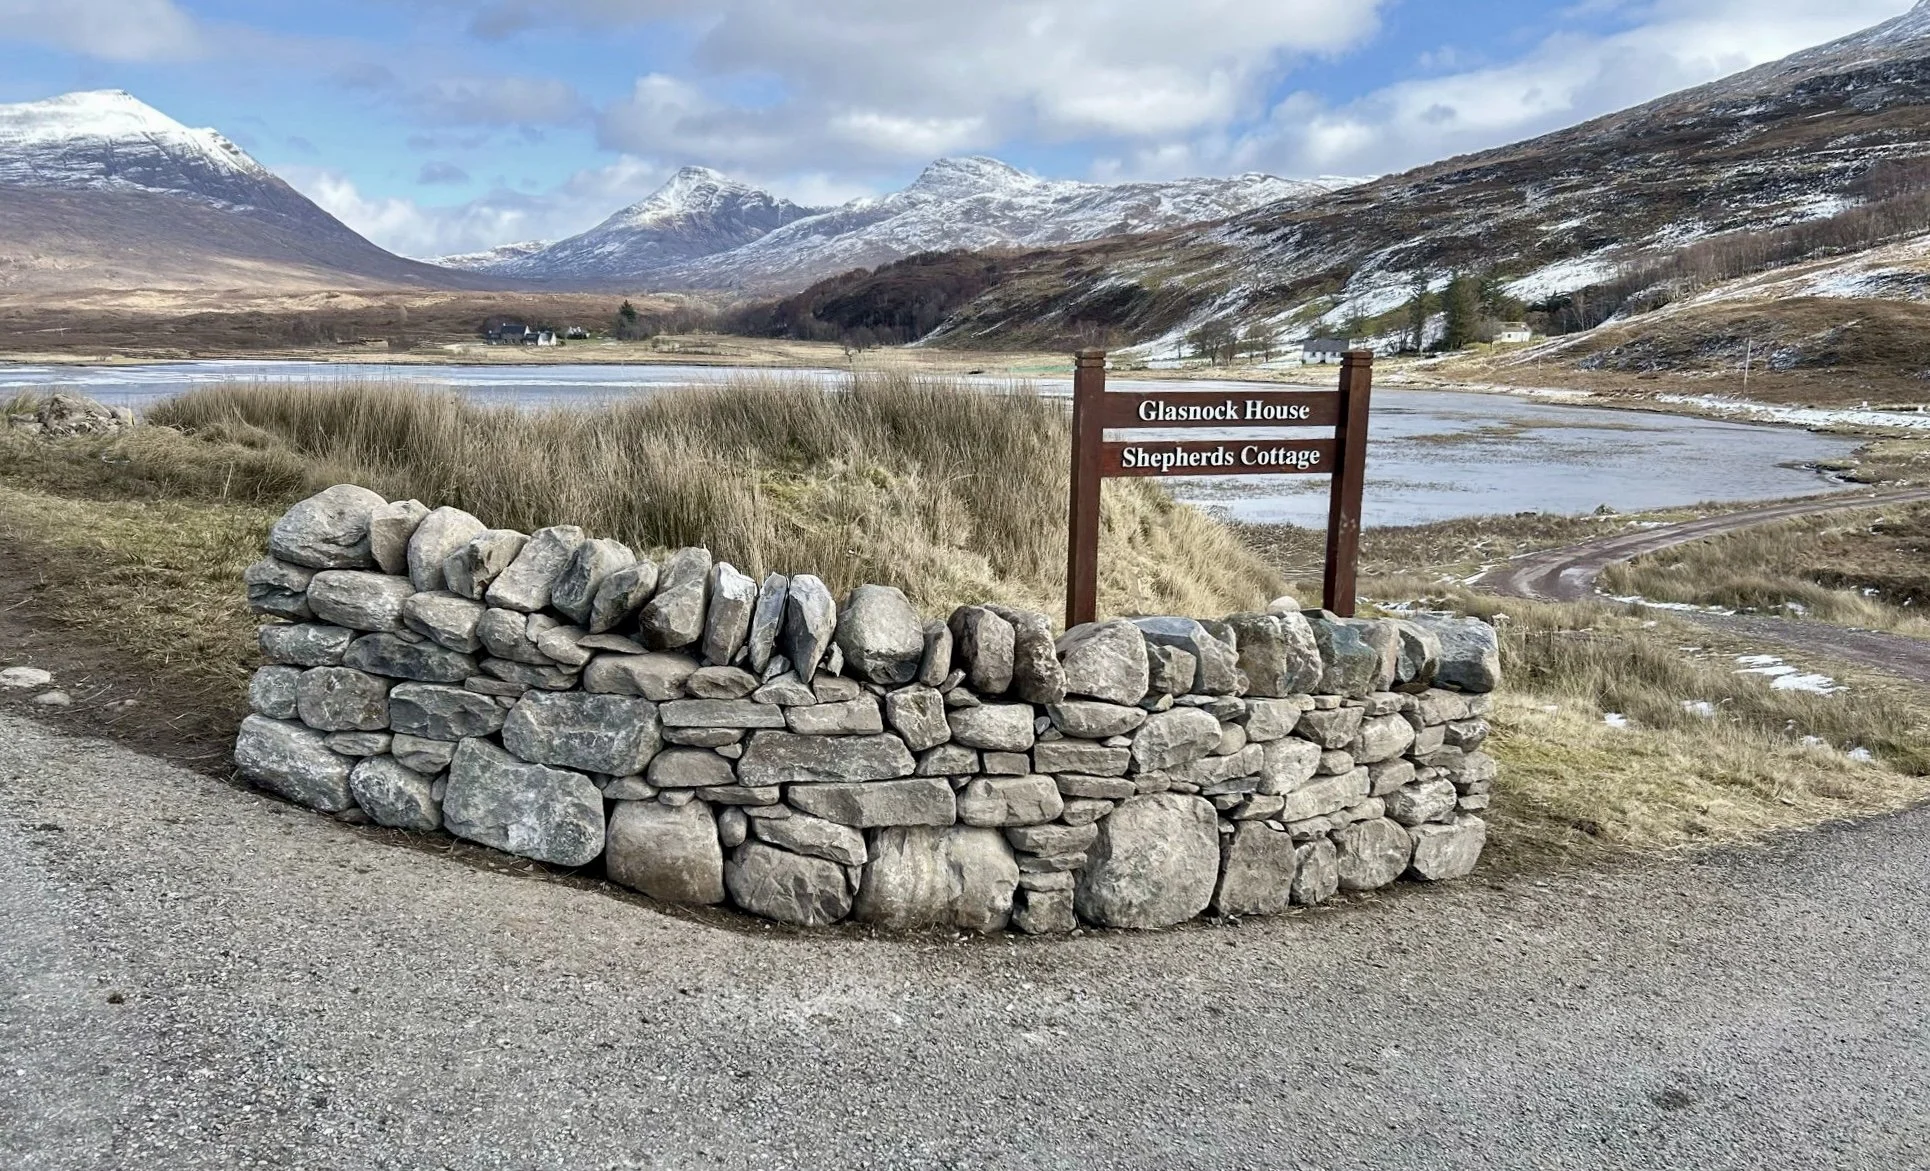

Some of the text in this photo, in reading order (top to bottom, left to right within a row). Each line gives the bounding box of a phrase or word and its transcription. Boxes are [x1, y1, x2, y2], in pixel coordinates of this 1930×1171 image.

[1138, 400, 1310, 421] Glasnock House
[1122, 445, 1321, 472] Shepherds Cottage
